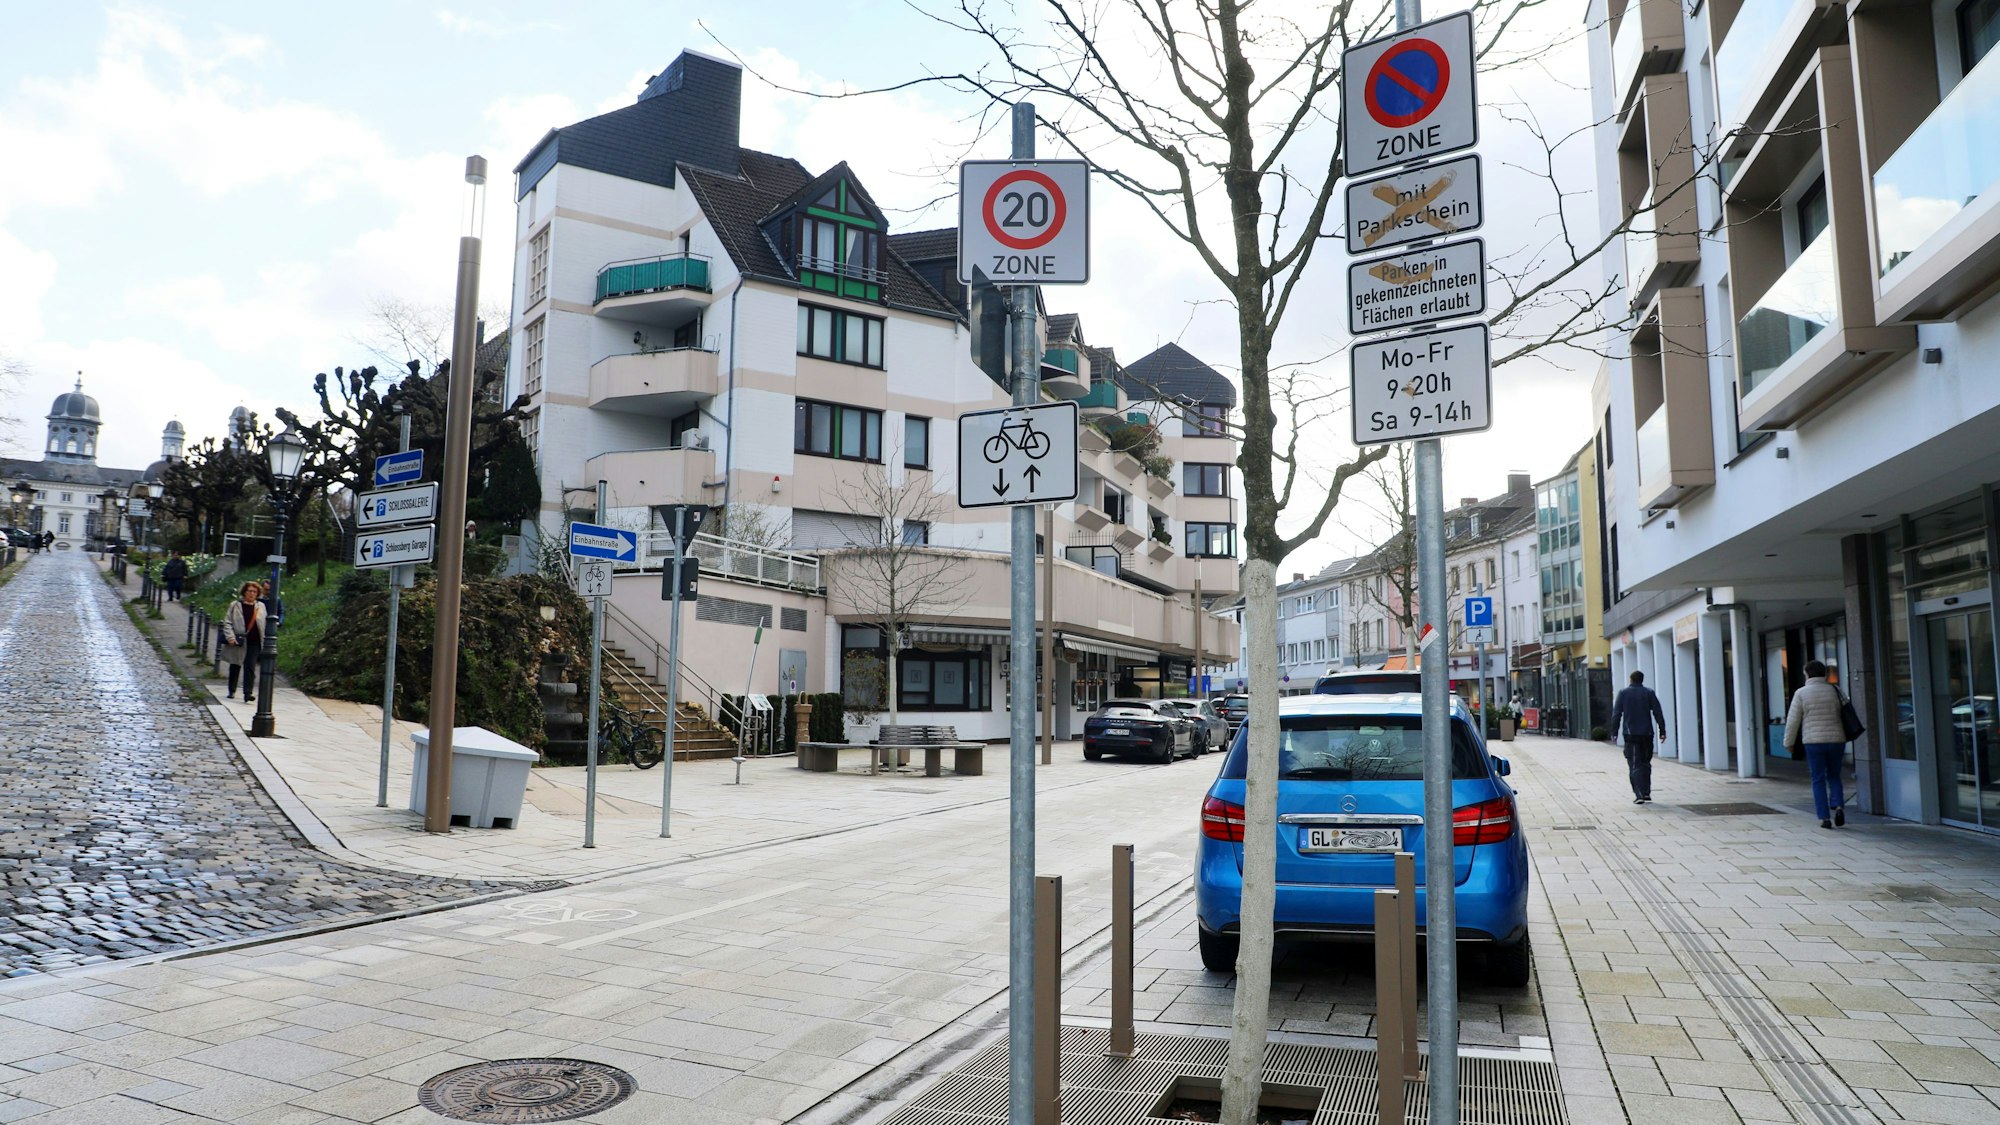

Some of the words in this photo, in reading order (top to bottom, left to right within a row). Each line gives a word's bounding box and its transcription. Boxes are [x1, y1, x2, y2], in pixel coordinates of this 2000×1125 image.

[1376, 124, 1442, 161] ZONE
[1002, 191, 1049, 228] 20
[1395, 184, 1428, 207] mit
[1357, 200, 1469, 238] Parkschein
[992, 255, 1056, 275] ZONE
[1381, 261, 1428, 282] Parken
[1434, 255, 1447, 272] in
[1355, 272, 1477, 310] gekennzeichneten
[1362, 305, 1413, 326] Flächen
[1420, 292, 1470, 315] erlaubt
[1381, 341, 1454, 371] Mo-Fr
[1370, 411, 1398, 432] Sa
[1410, 400, 1472, 427] 9-14h
[388, 496, 429, 511] SCHLOSSGALERIE
[412, 540, 427, 551] Garage
[574, 535, 619, 549] Einbahnstraße
[1311, 831, 1330, 847] GL
